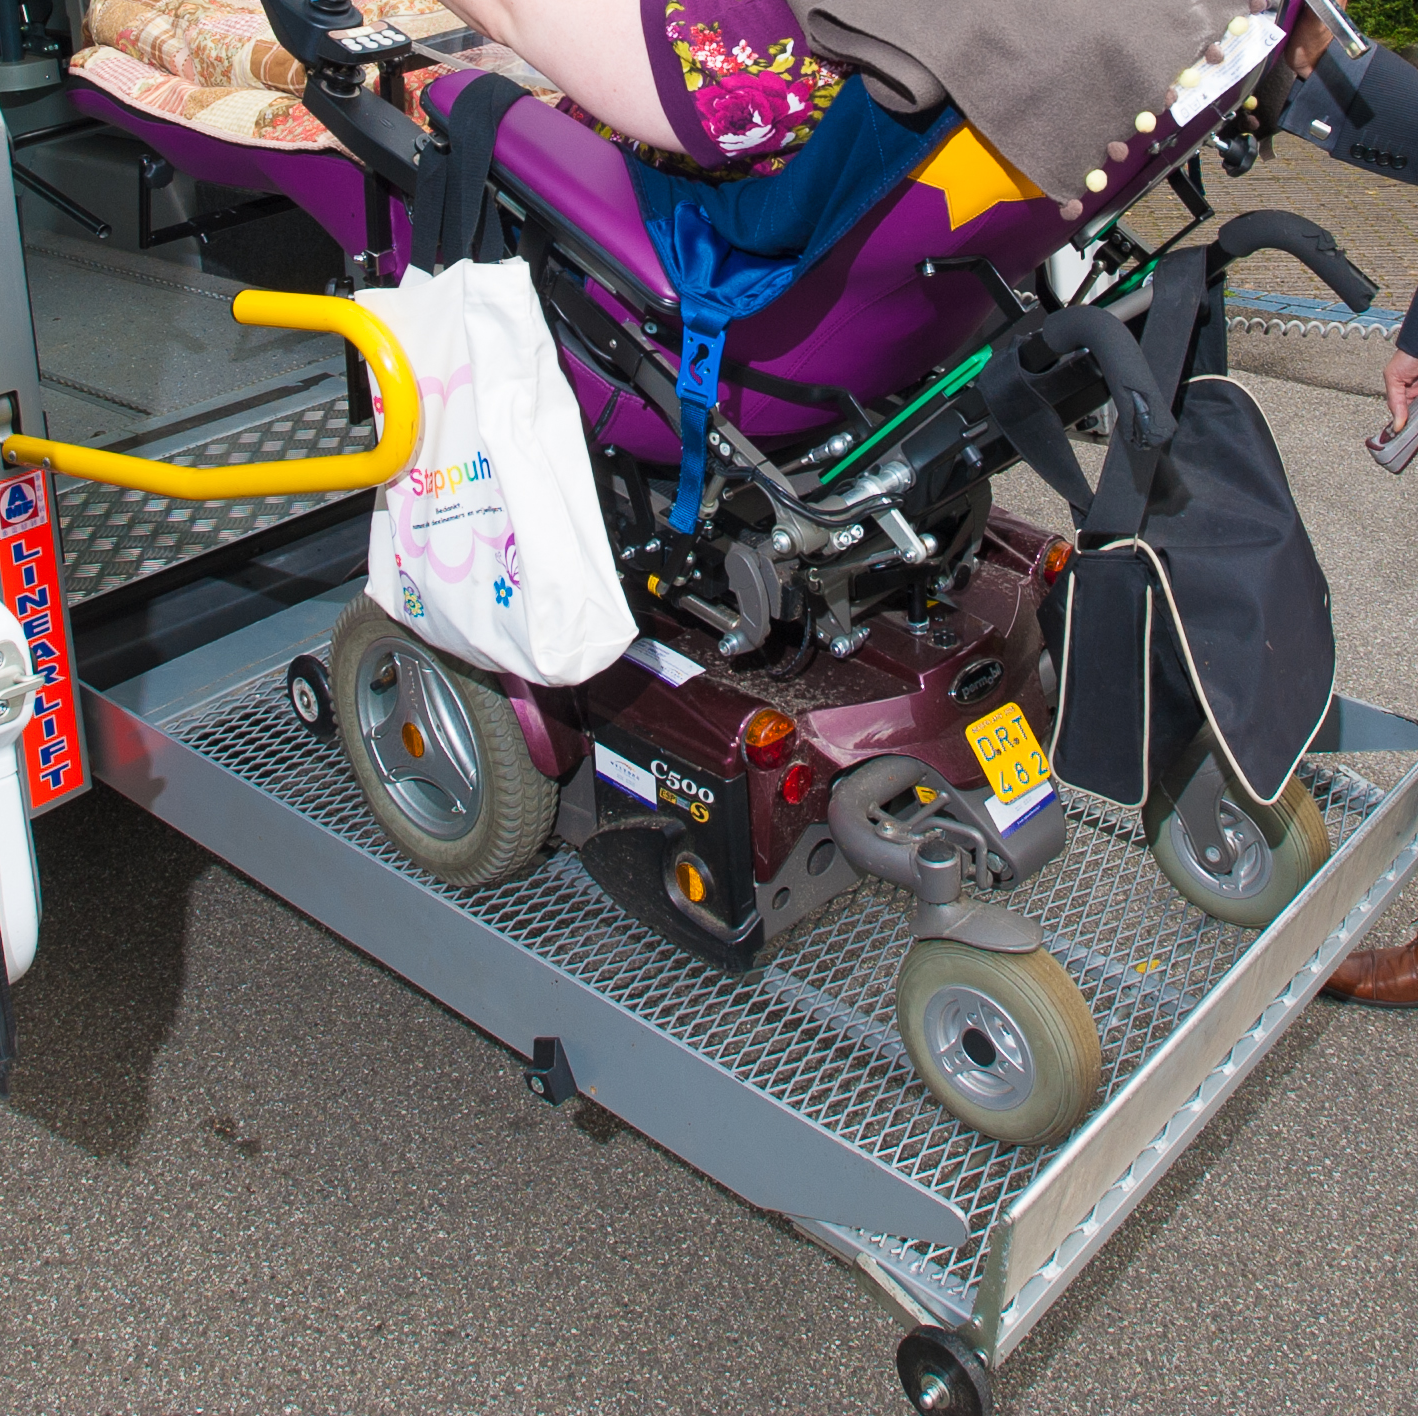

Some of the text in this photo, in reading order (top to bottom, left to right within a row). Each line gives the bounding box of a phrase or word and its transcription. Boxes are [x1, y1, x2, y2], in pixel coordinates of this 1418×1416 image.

[11, 538, 72, 791] LINEAR LIFT
[961, 663, 1003, 700] permobil
[650, 759, 715, 804] C500
